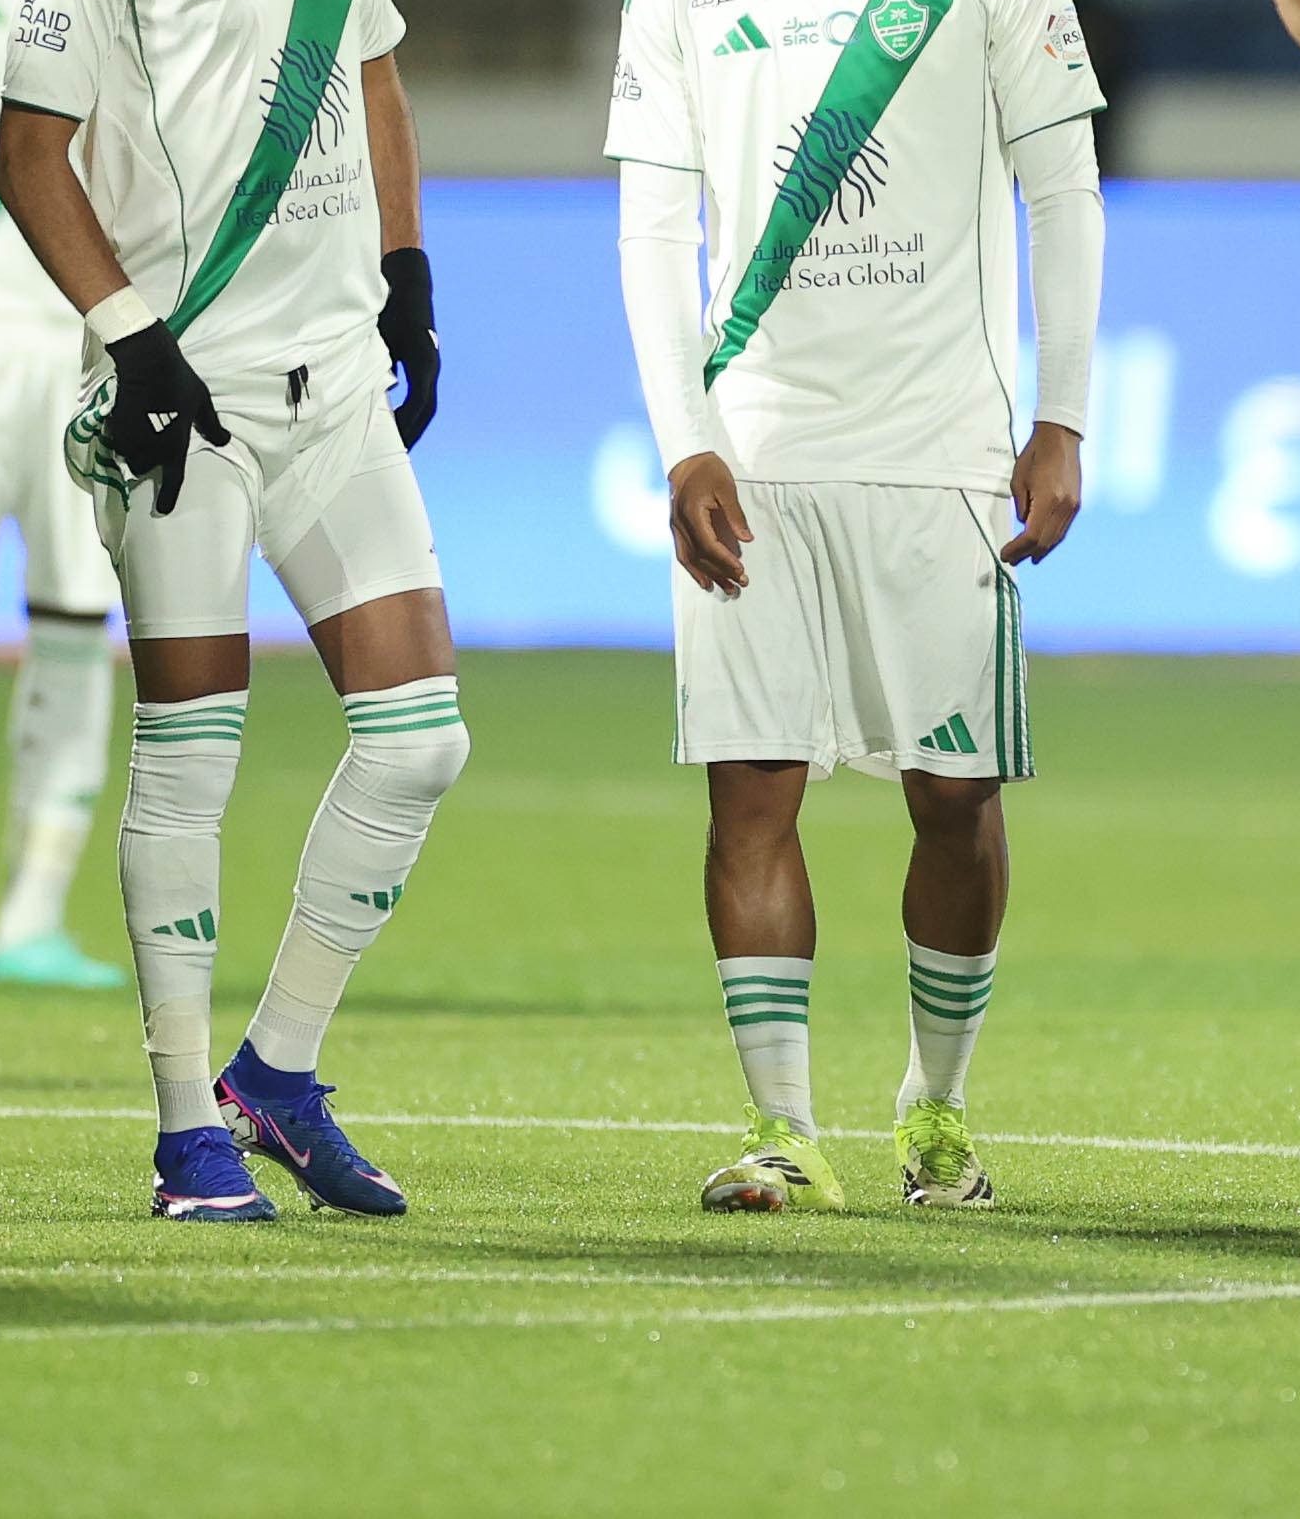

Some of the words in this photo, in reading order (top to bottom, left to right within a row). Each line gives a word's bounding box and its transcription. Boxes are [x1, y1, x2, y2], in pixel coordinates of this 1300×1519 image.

[19, 3, 71, 33] QAID
[783, 17, 819, 31] سرك
[15, 27, 66, 52] قايد
[783, 34, 819, 46] SIRC
[236, 202, 280, 226] Red
[285, 202, 319, 223] Sea
[753, 237, 820, 264] الدولية
[823, 234, 879, 261] الأحمر
[883, 233, 924, 257] البحر
[755, 267, 792, 293] Red
[798, 268, 840, 289] Sea
[847, 261, 925, 286] Global
